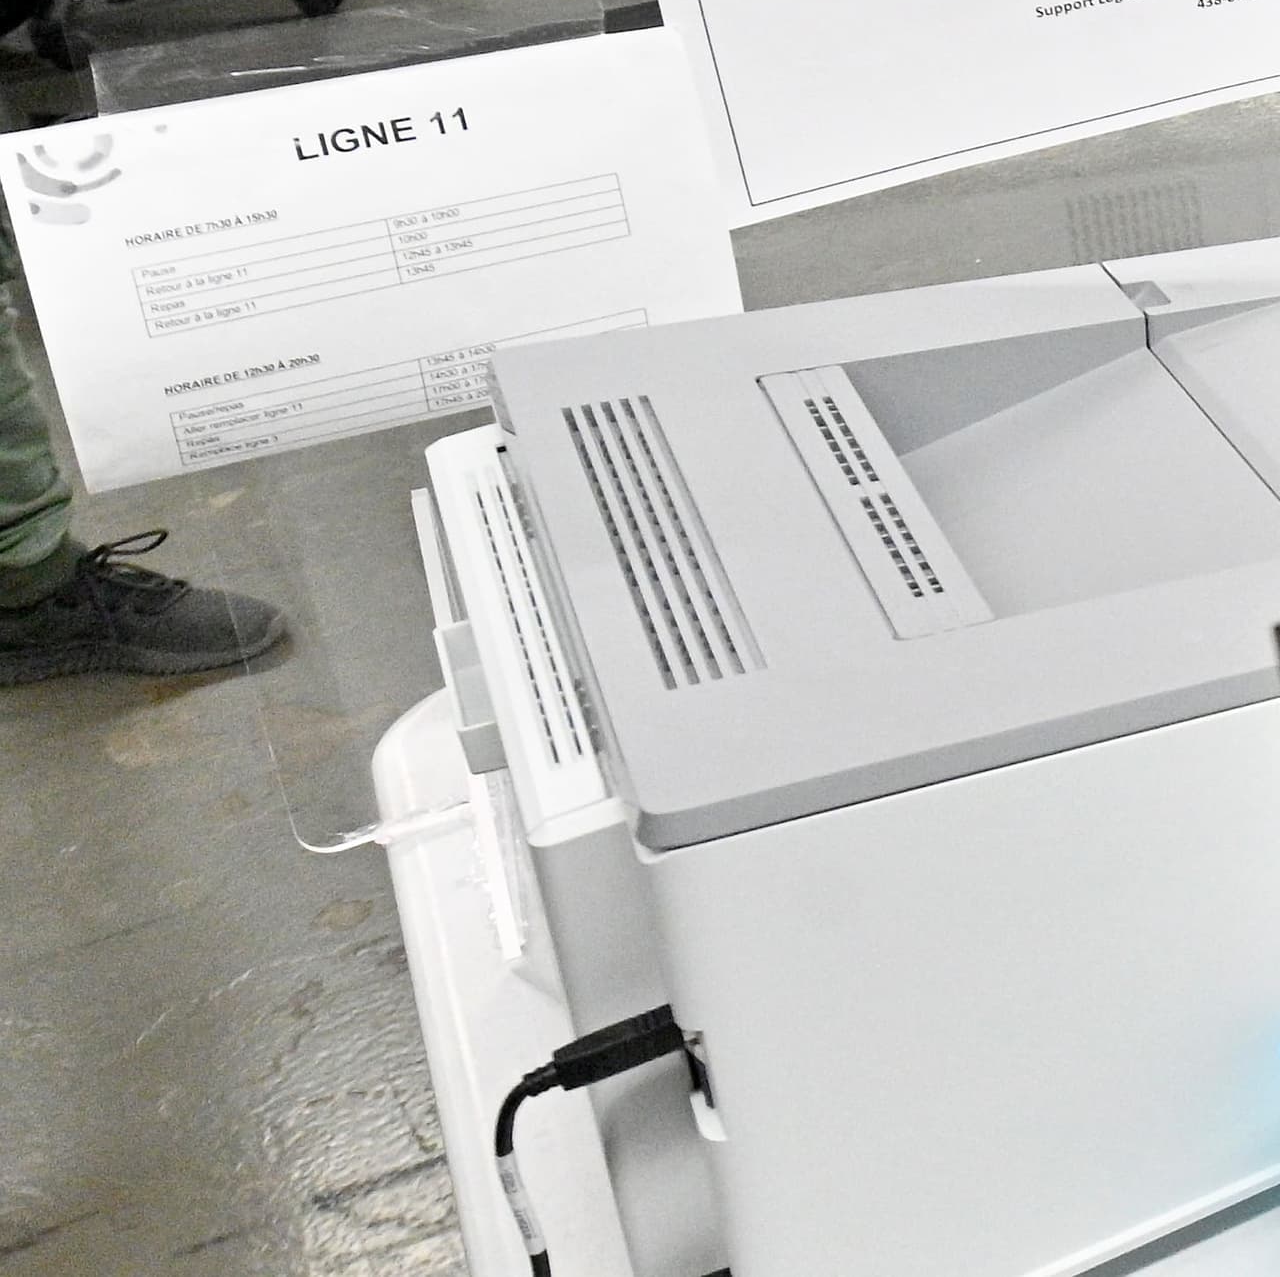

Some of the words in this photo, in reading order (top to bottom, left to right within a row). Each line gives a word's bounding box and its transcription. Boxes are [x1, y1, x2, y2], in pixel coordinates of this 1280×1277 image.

[293, 117, 417, 161] LIGNE
[430, 107, 468, 134] 11
[125, 227, 182, 247] HORAIRE
[185, 224, 203, 235] DE
[205, 219, 232, 230] 7h30
[247, 209, 278, 223] 15h30
[146, 283, 182, 296] Retour
[208, 272, 232, 284] ligne
[155, 316, 191, 330] Retour
[216, 305, 241, 318] ligne
[164, 374, 221, 395] HORAIRE
[223, 370, 239, 383] DE
[244, 363, 275, 378] 12h30
[288, 354, 320, 368] 20h30
